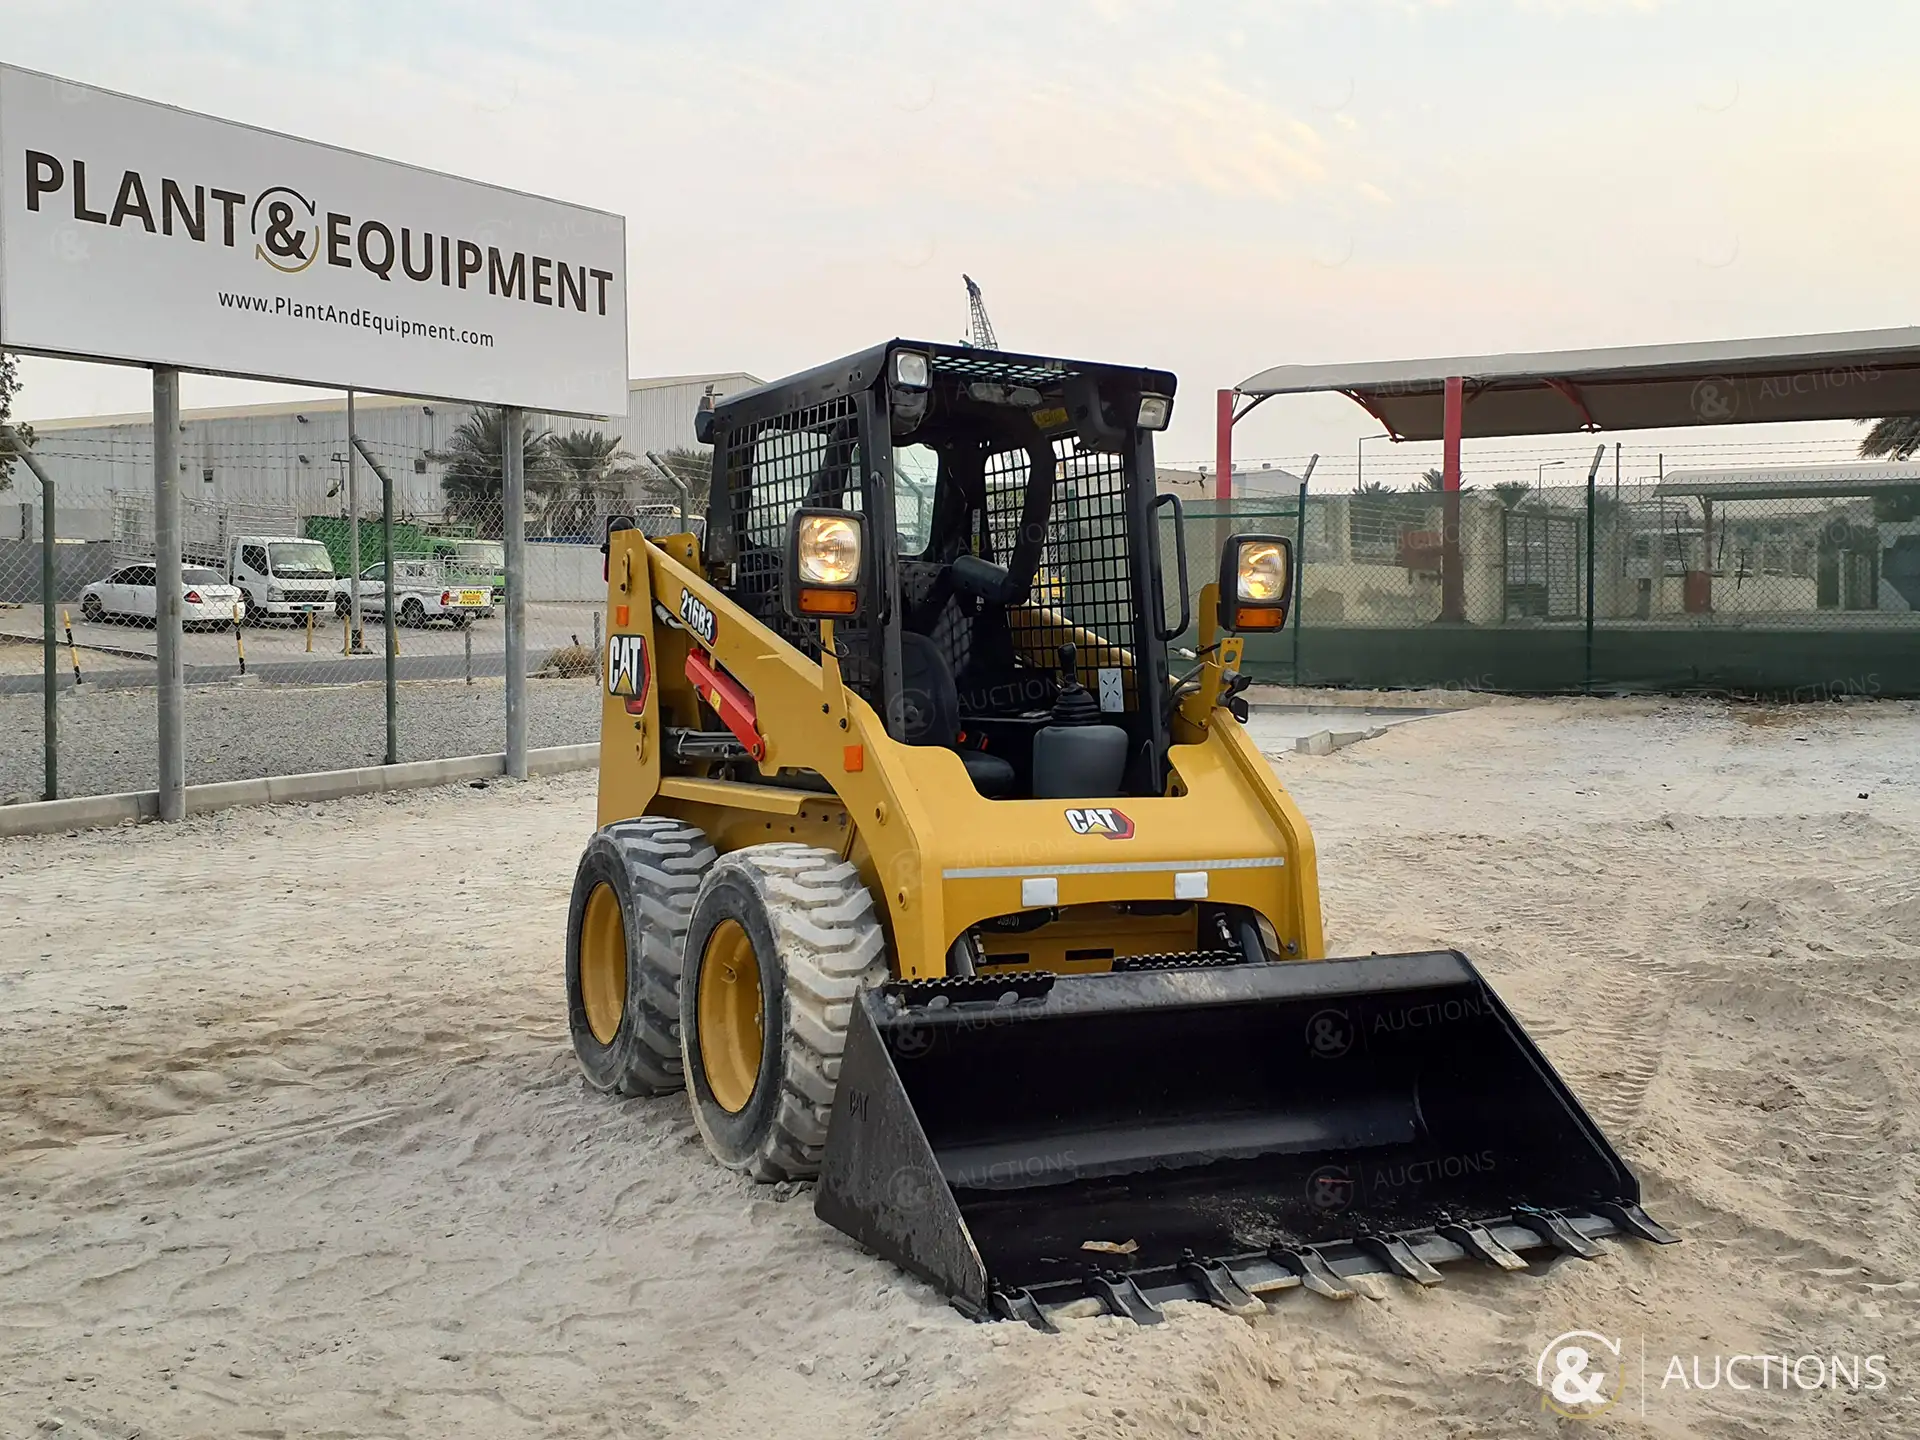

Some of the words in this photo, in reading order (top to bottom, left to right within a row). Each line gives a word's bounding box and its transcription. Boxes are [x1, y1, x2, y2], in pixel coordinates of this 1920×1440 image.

[218, 291, 495, 348] www.PlantAndEquipment.com
[679, 588, 713, 642] 216B3
[609, 634, 641, 695] CAT
[1067, 808, 1119, 834] CAT
